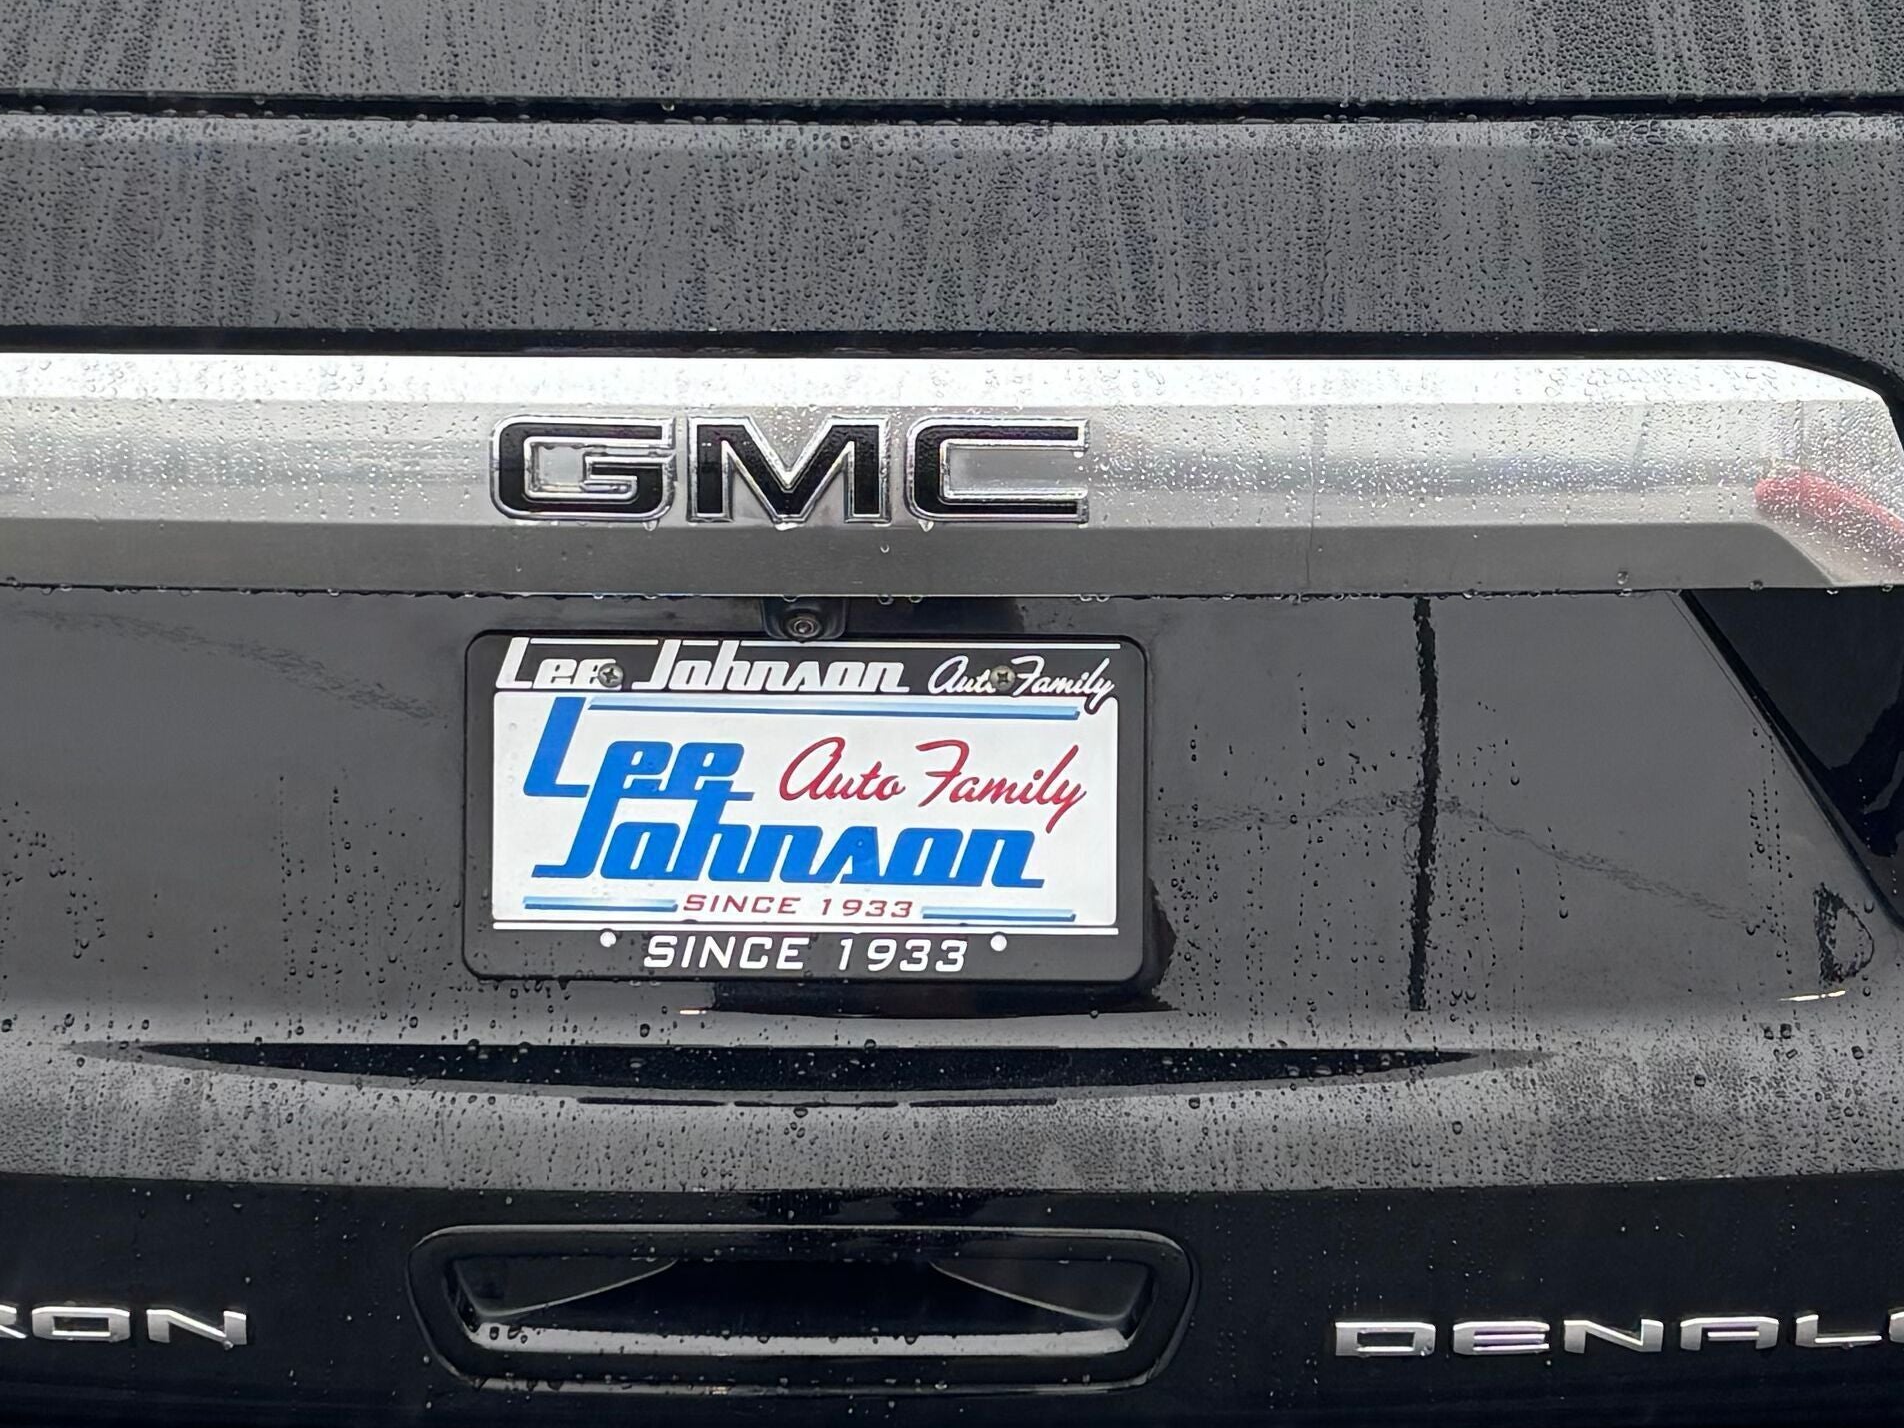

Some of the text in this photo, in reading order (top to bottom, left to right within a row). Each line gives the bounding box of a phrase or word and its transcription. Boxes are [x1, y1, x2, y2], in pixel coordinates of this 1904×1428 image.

[490, 414, 1089, 523] GMC
[496, 637, 1114, 710] Lee Johnson Aut Family
[523, 697, 754, 801] Lee
[779, 736, 1088, 833] Auto Family
[532, 790, 1045, 888] Johnson
[644, 936, 967, 972] SINCE 1933
[683, 894, 913, 919] SINCE 1933
